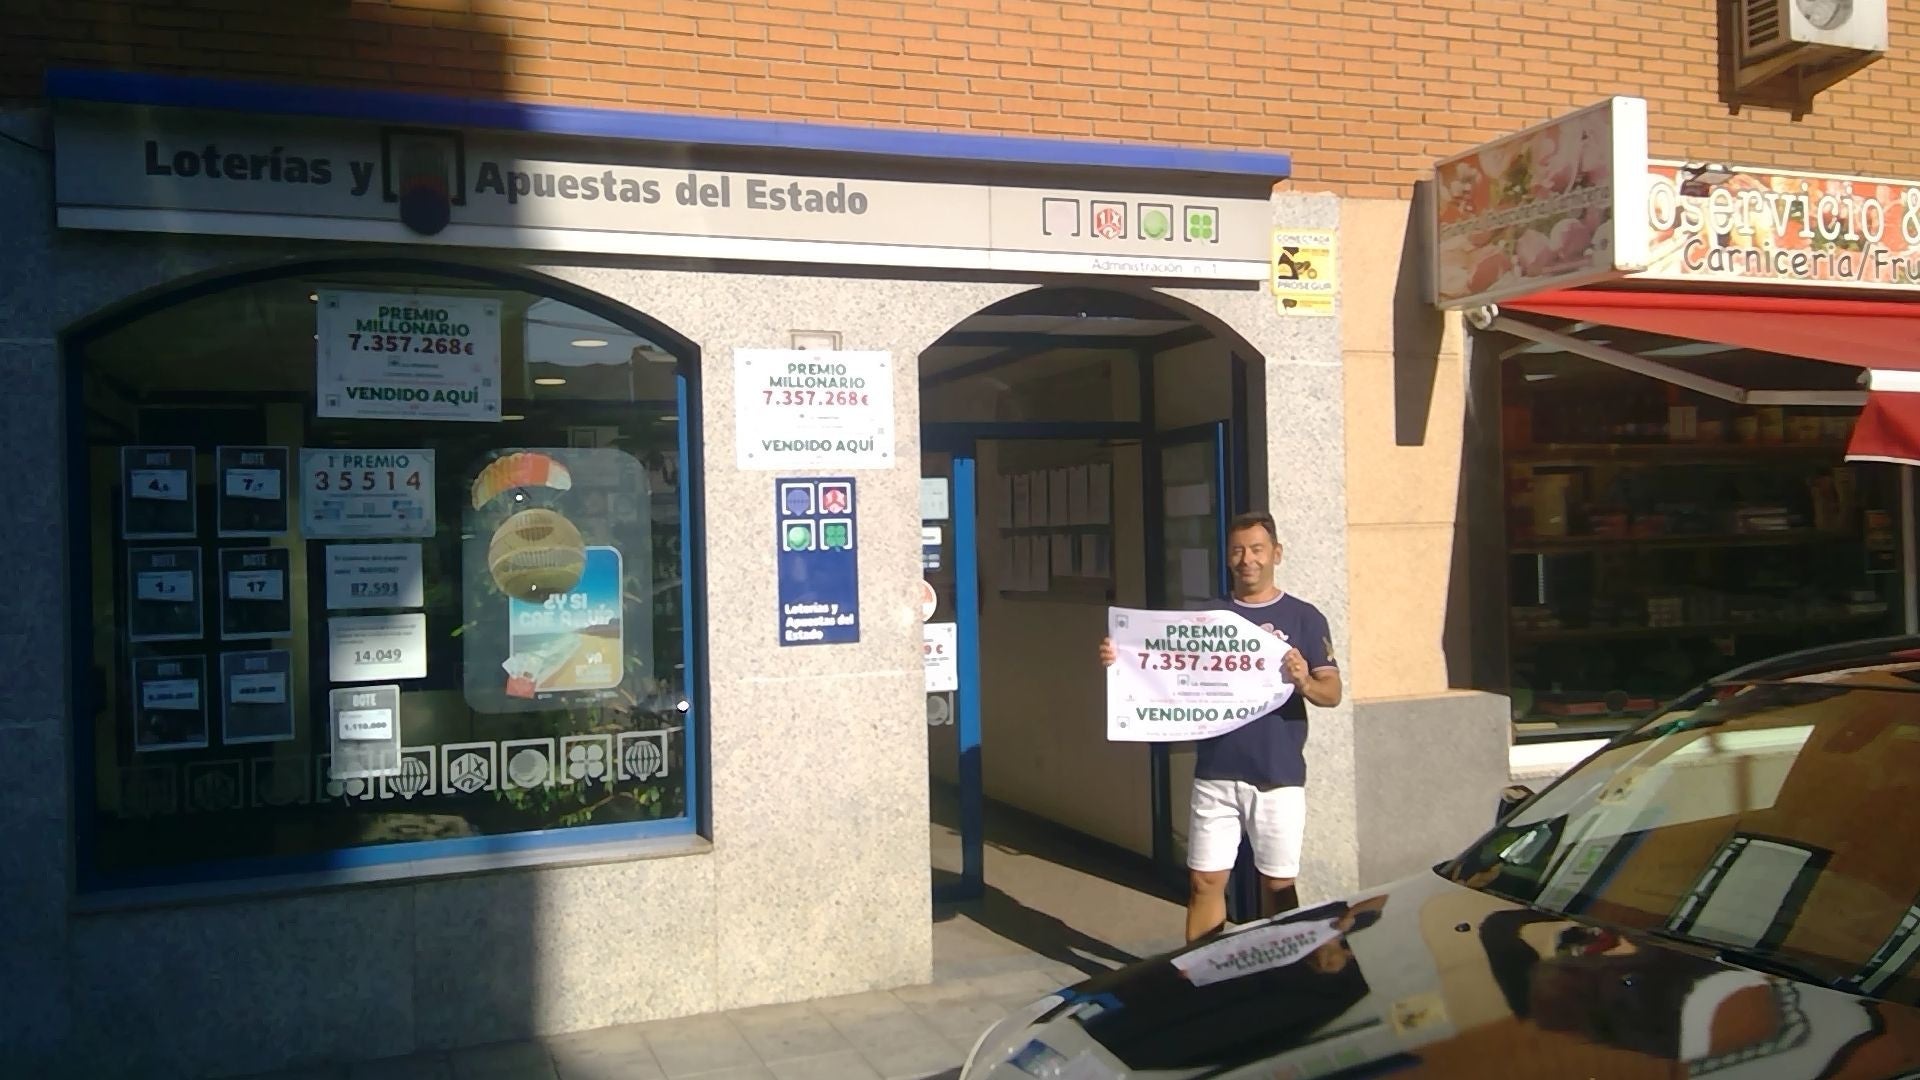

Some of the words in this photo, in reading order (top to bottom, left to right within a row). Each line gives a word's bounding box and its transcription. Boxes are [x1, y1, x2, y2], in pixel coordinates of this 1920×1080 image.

[144, 140, 332, 185] Loterías
[350, 160, 375, 197] y
[473, 161, 661, 205] Apuestas
[675, 173, 731, 208] del
[746, 178, 869, 215] Estado
[1277, 280, 1332, 291] PROSEGUR
[378, 306, 449, 323] PREMIO
[355, 319, 471, 338] MILLONARIO
[787, 363, 847, 376] PREMIO
[769, 376, 866, 389] MILLONARIO
[346, 386, 430, 402] VENDIDO
[433, 385, 479, 406] AQUÍ
[761, 439, 833, 452] VENDIDO
[835, 435, 874, 454] AQUÍ
[343, 455, 410, 469] PREMIO
[1165, 624, 1239, 639] PREMIO
[1144, 638, 1261, 653] MILLONARIO
[354, 647, 402, 663] 14.049
[1136, 707, 1219, 722] VENDIDO
